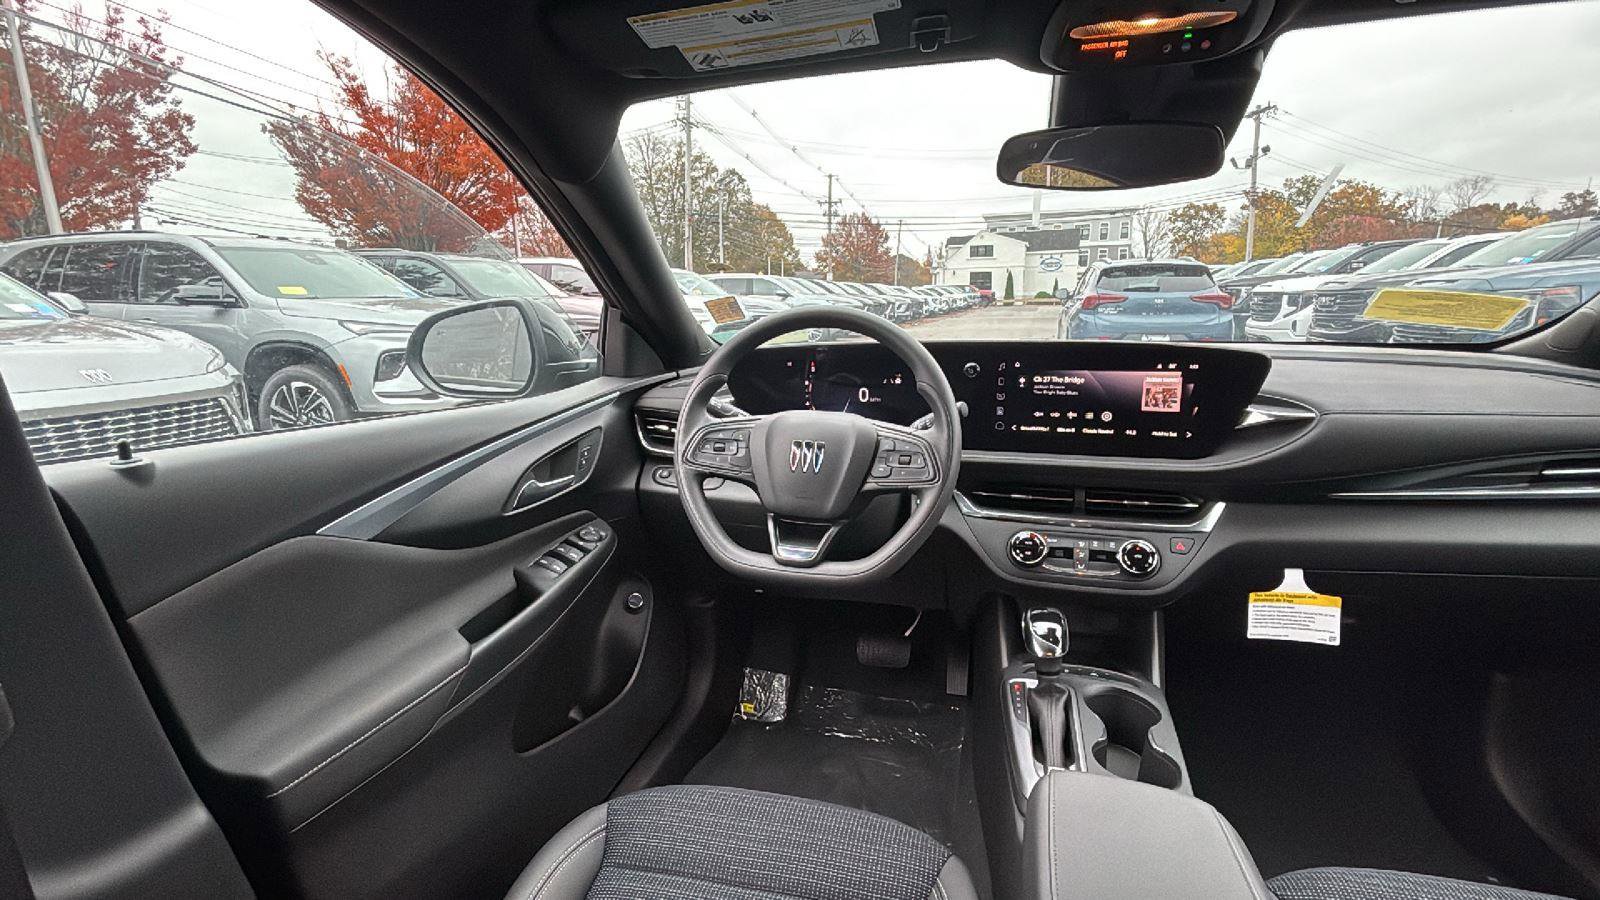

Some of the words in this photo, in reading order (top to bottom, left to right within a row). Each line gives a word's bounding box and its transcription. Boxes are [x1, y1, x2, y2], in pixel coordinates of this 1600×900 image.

[1115, 50, 1127, 58] OFF
[1051, 376, 1063, 384] The
[1064, 377, 1085, 385] Bridge
[858, 387, 869, 403] 0
